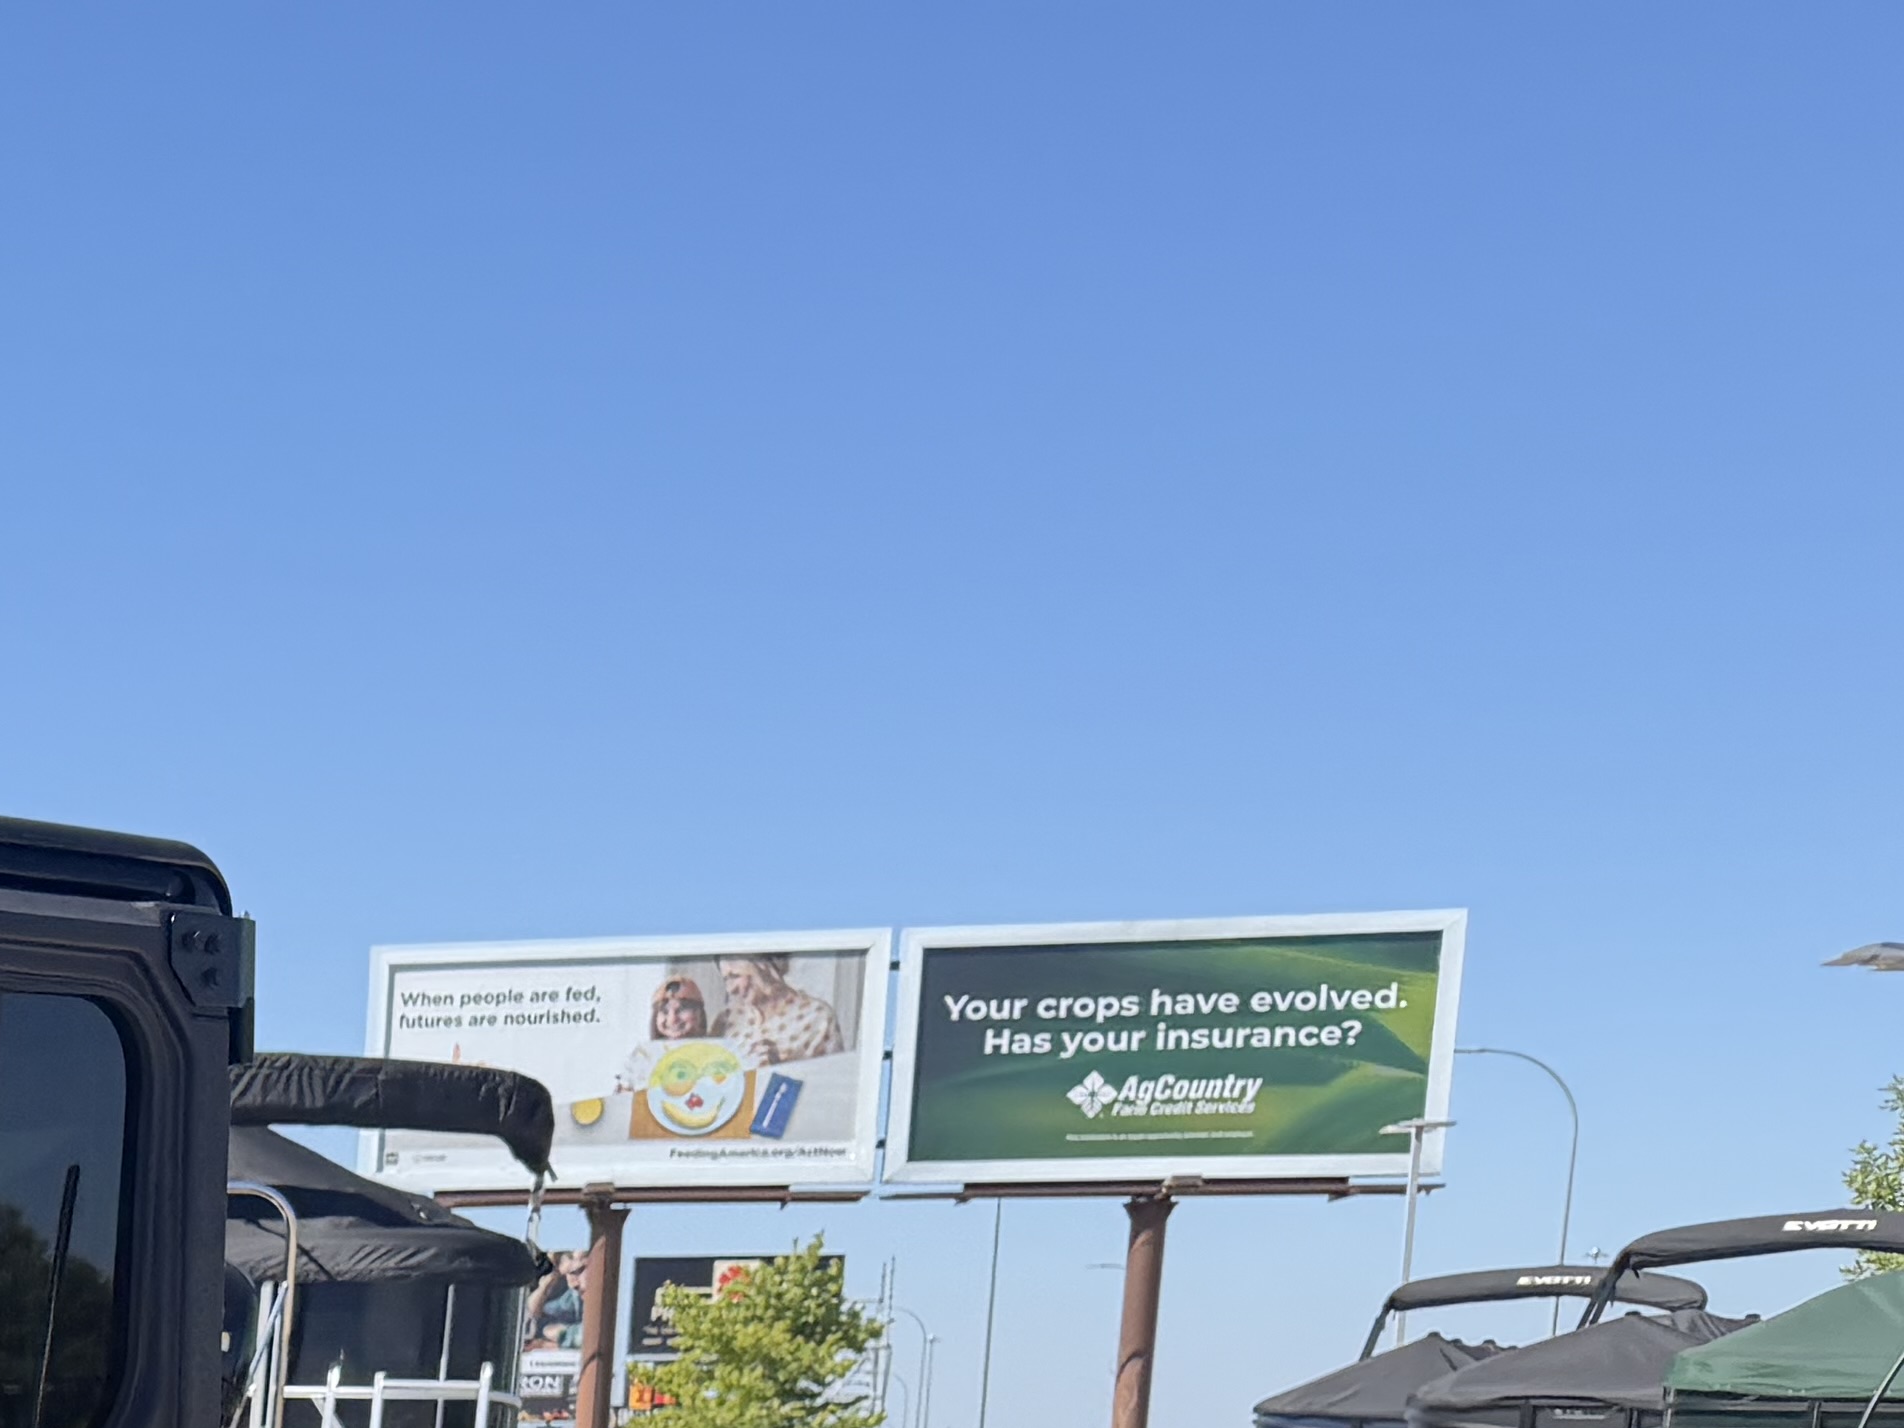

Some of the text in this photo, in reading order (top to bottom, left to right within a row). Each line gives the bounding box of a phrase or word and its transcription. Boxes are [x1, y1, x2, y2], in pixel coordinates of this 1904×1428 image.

[400, 985, 602, 1009] When people are fed,
[944, 982, 1409, 1024] Your crops have evolved.
[399, 1008, 601, 1030] futures are nourished.
[983, 1019, 1363, 1060] Has your insurance?
[1117, 1074, 1263, 1104] AgCountry
[1149, 1101, 1193, 1116] Credit
[1195, 1100, 1256, 1115] Services
